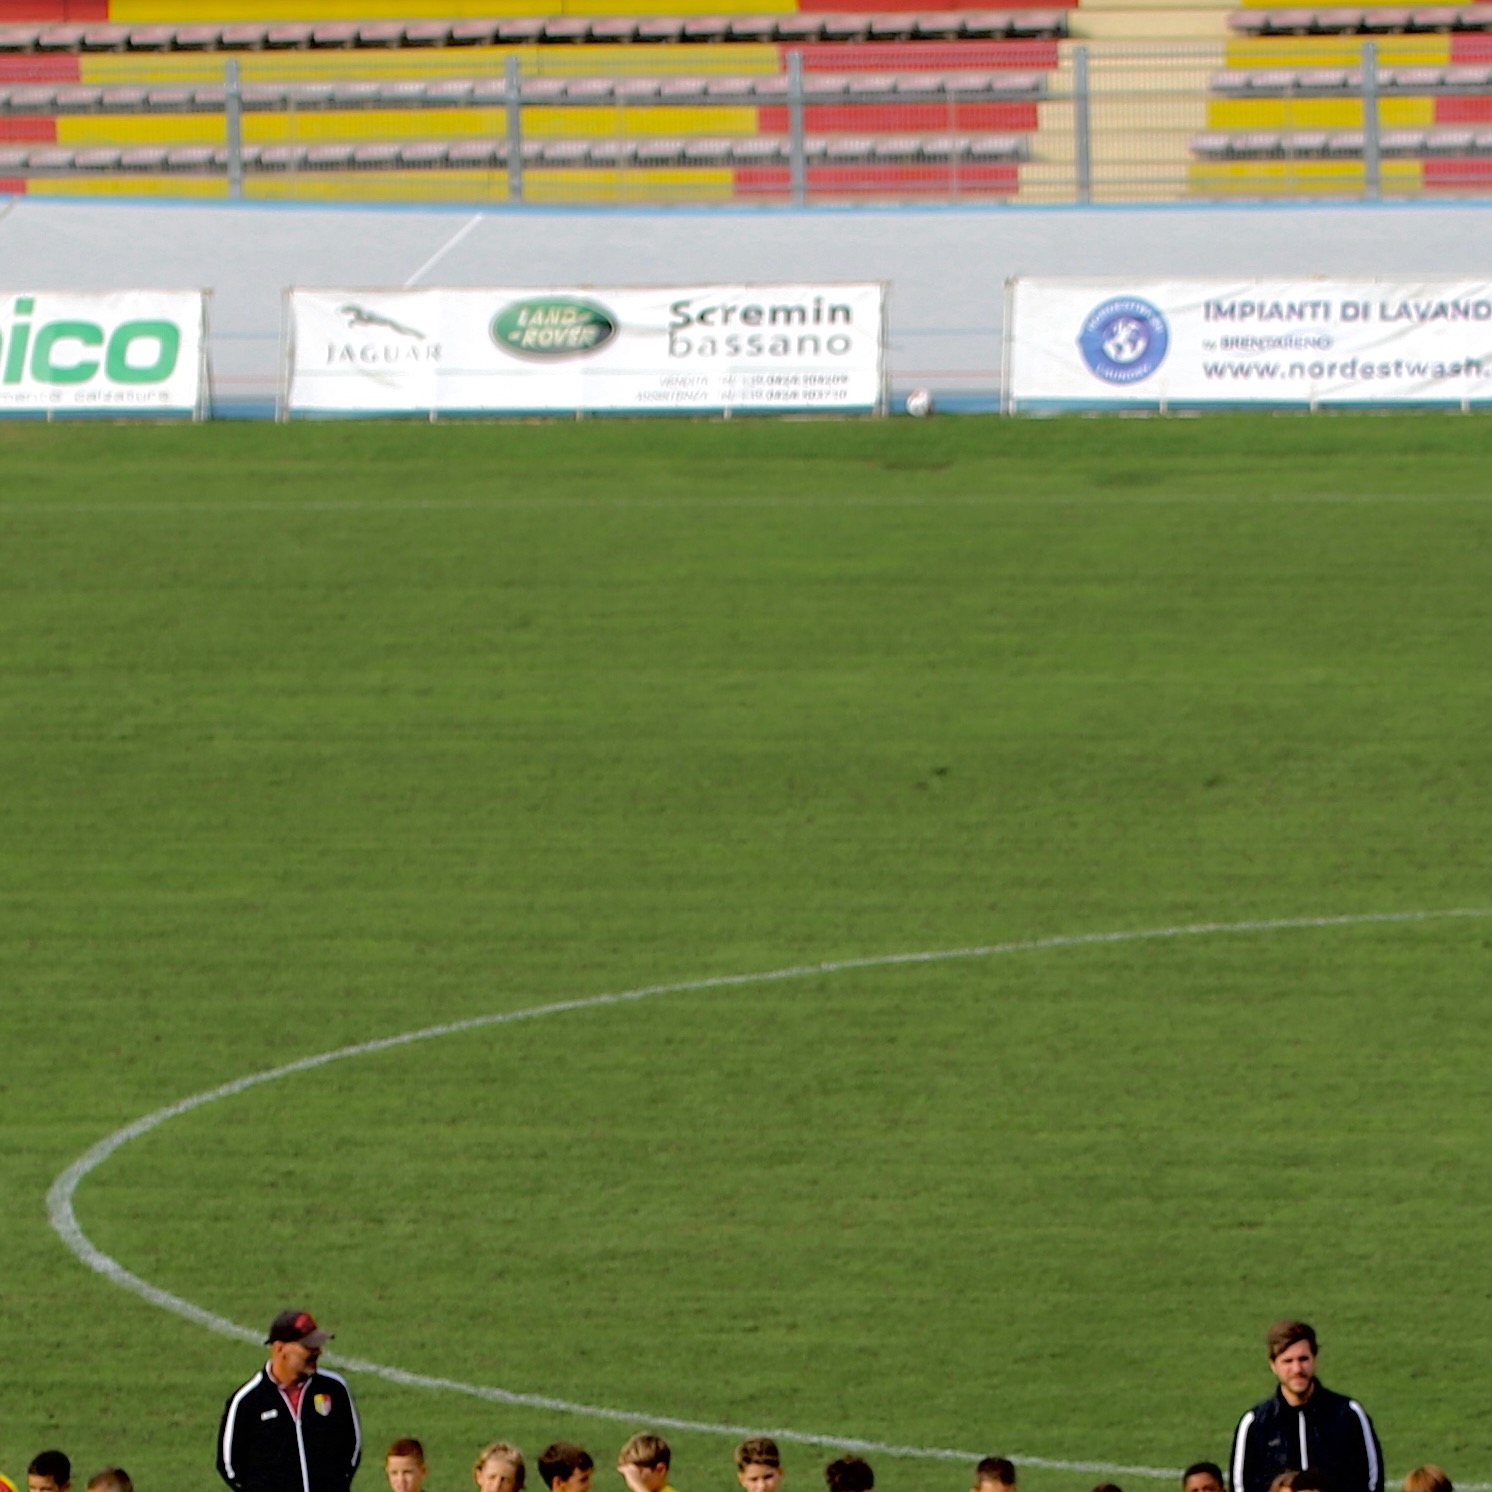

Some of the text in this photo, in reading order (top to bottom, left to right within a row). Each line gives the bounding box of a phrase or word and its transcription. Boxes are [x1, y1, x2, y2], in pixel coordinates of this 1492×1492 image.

[667, 296, 853, 328] Scremin
[1203, 300, 1327, 322] IMPIANTI
[1340, 300, 1371, 322] DI
[0, 297, 180, 385] ico
[326, 342, 443, 364] JAGUAR
[667, 329, 852, 358] bassano
